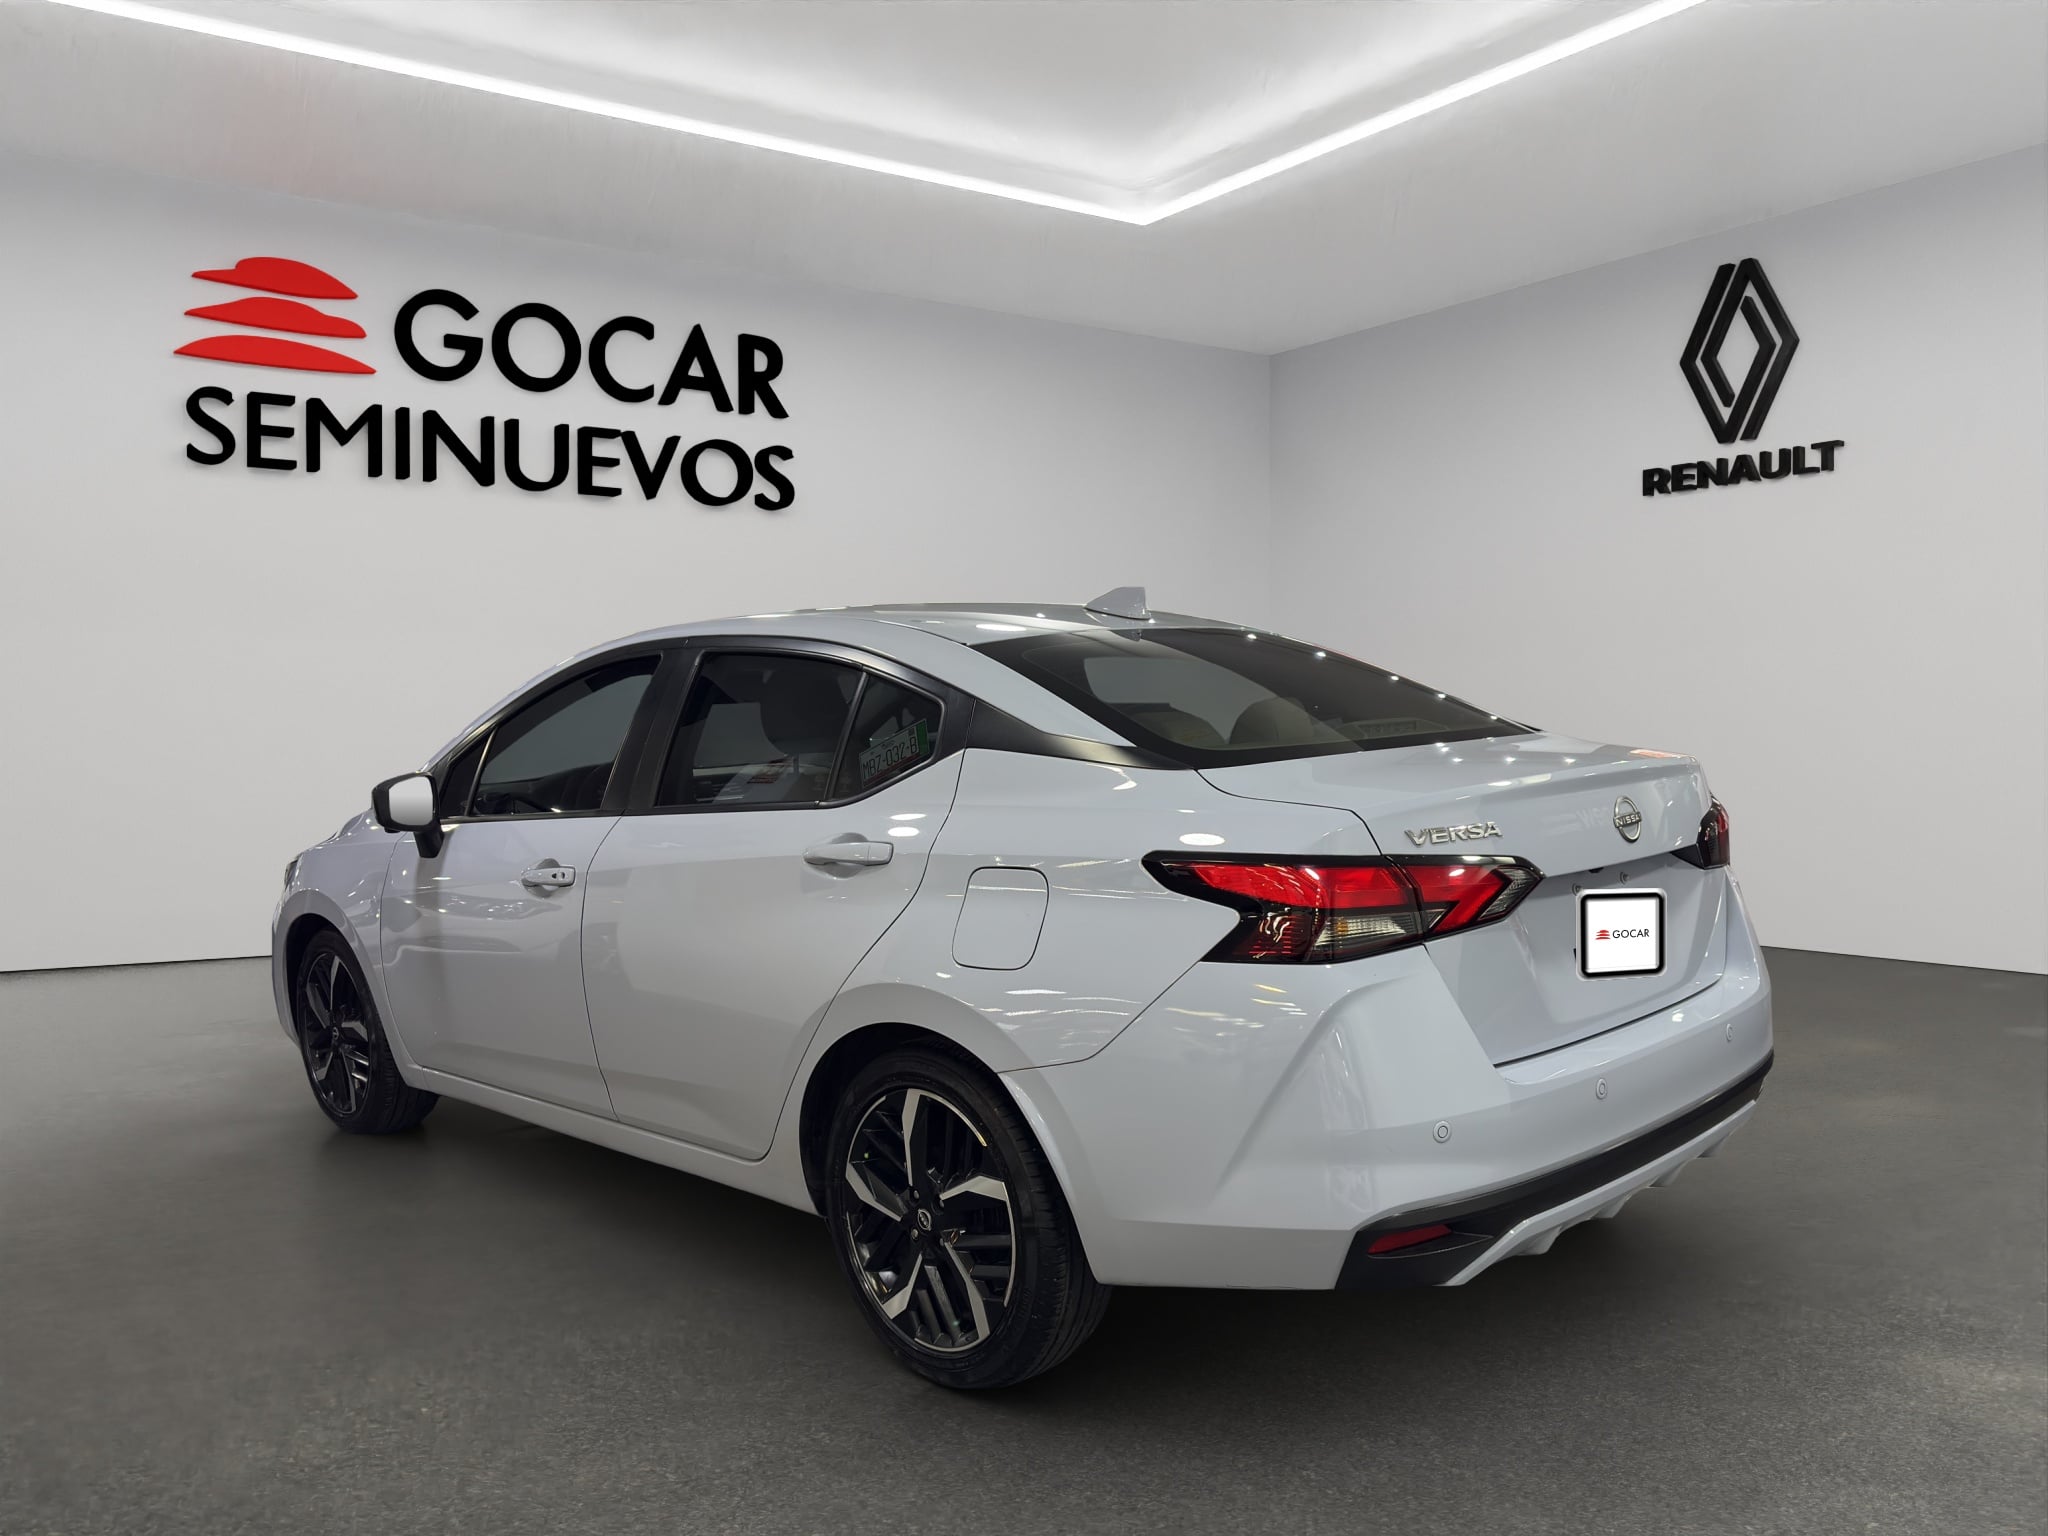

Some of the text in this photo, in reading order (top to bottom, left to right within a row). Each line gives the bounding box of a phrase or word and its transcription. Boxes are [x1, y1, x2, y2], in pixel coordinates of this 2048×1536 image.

[393, 288, 789, 419] GOCAR
[186, 386, 795, 511] SEMINUEVOS
[1642, 440, 1845, 496] RENAULT
[1404, 821, 1503, 846] VERSA
[1615, 813, 1640, 826] NISSA
